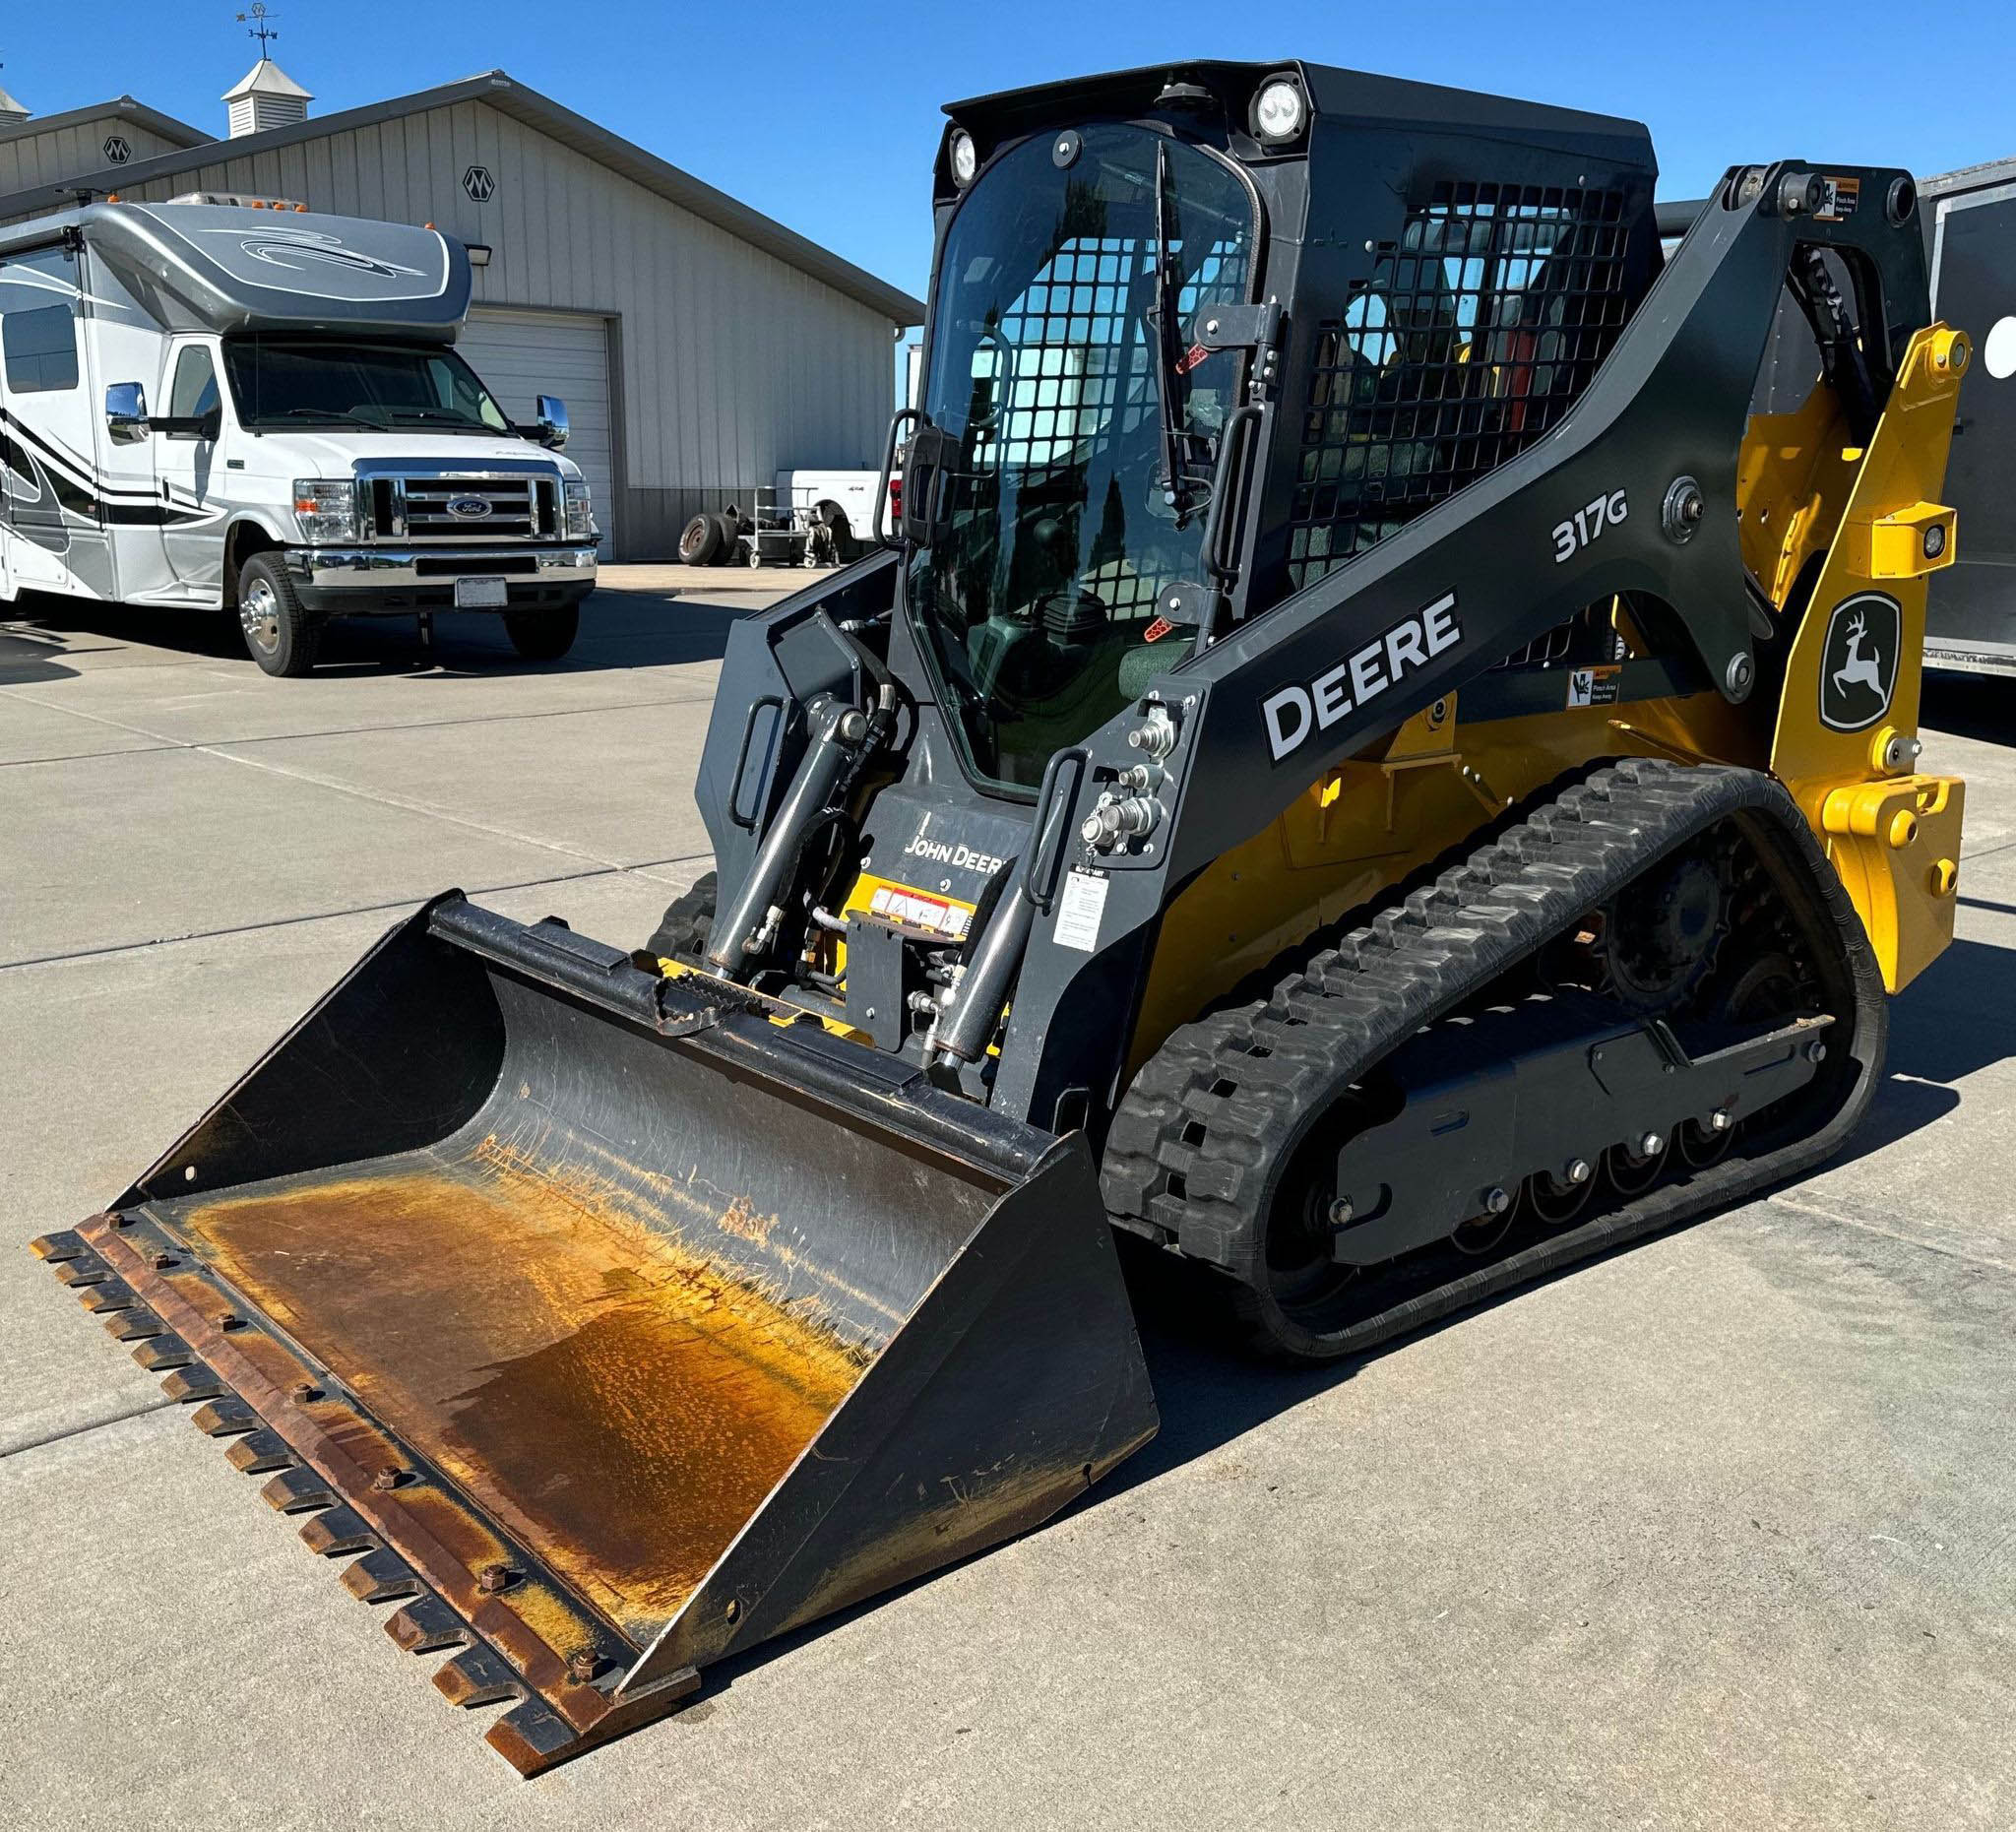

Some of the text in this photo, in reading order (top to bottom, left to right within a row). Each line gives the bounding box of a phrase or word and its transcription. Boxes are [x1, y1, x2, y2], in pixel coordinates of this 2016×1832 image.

[462, 502, 482, 513] Ford
[1551, 489, 1628, 563] 317G
[1263, 593, 1461, 762] DEERE
[905, 835, 1007, 874] JOHN DEER
